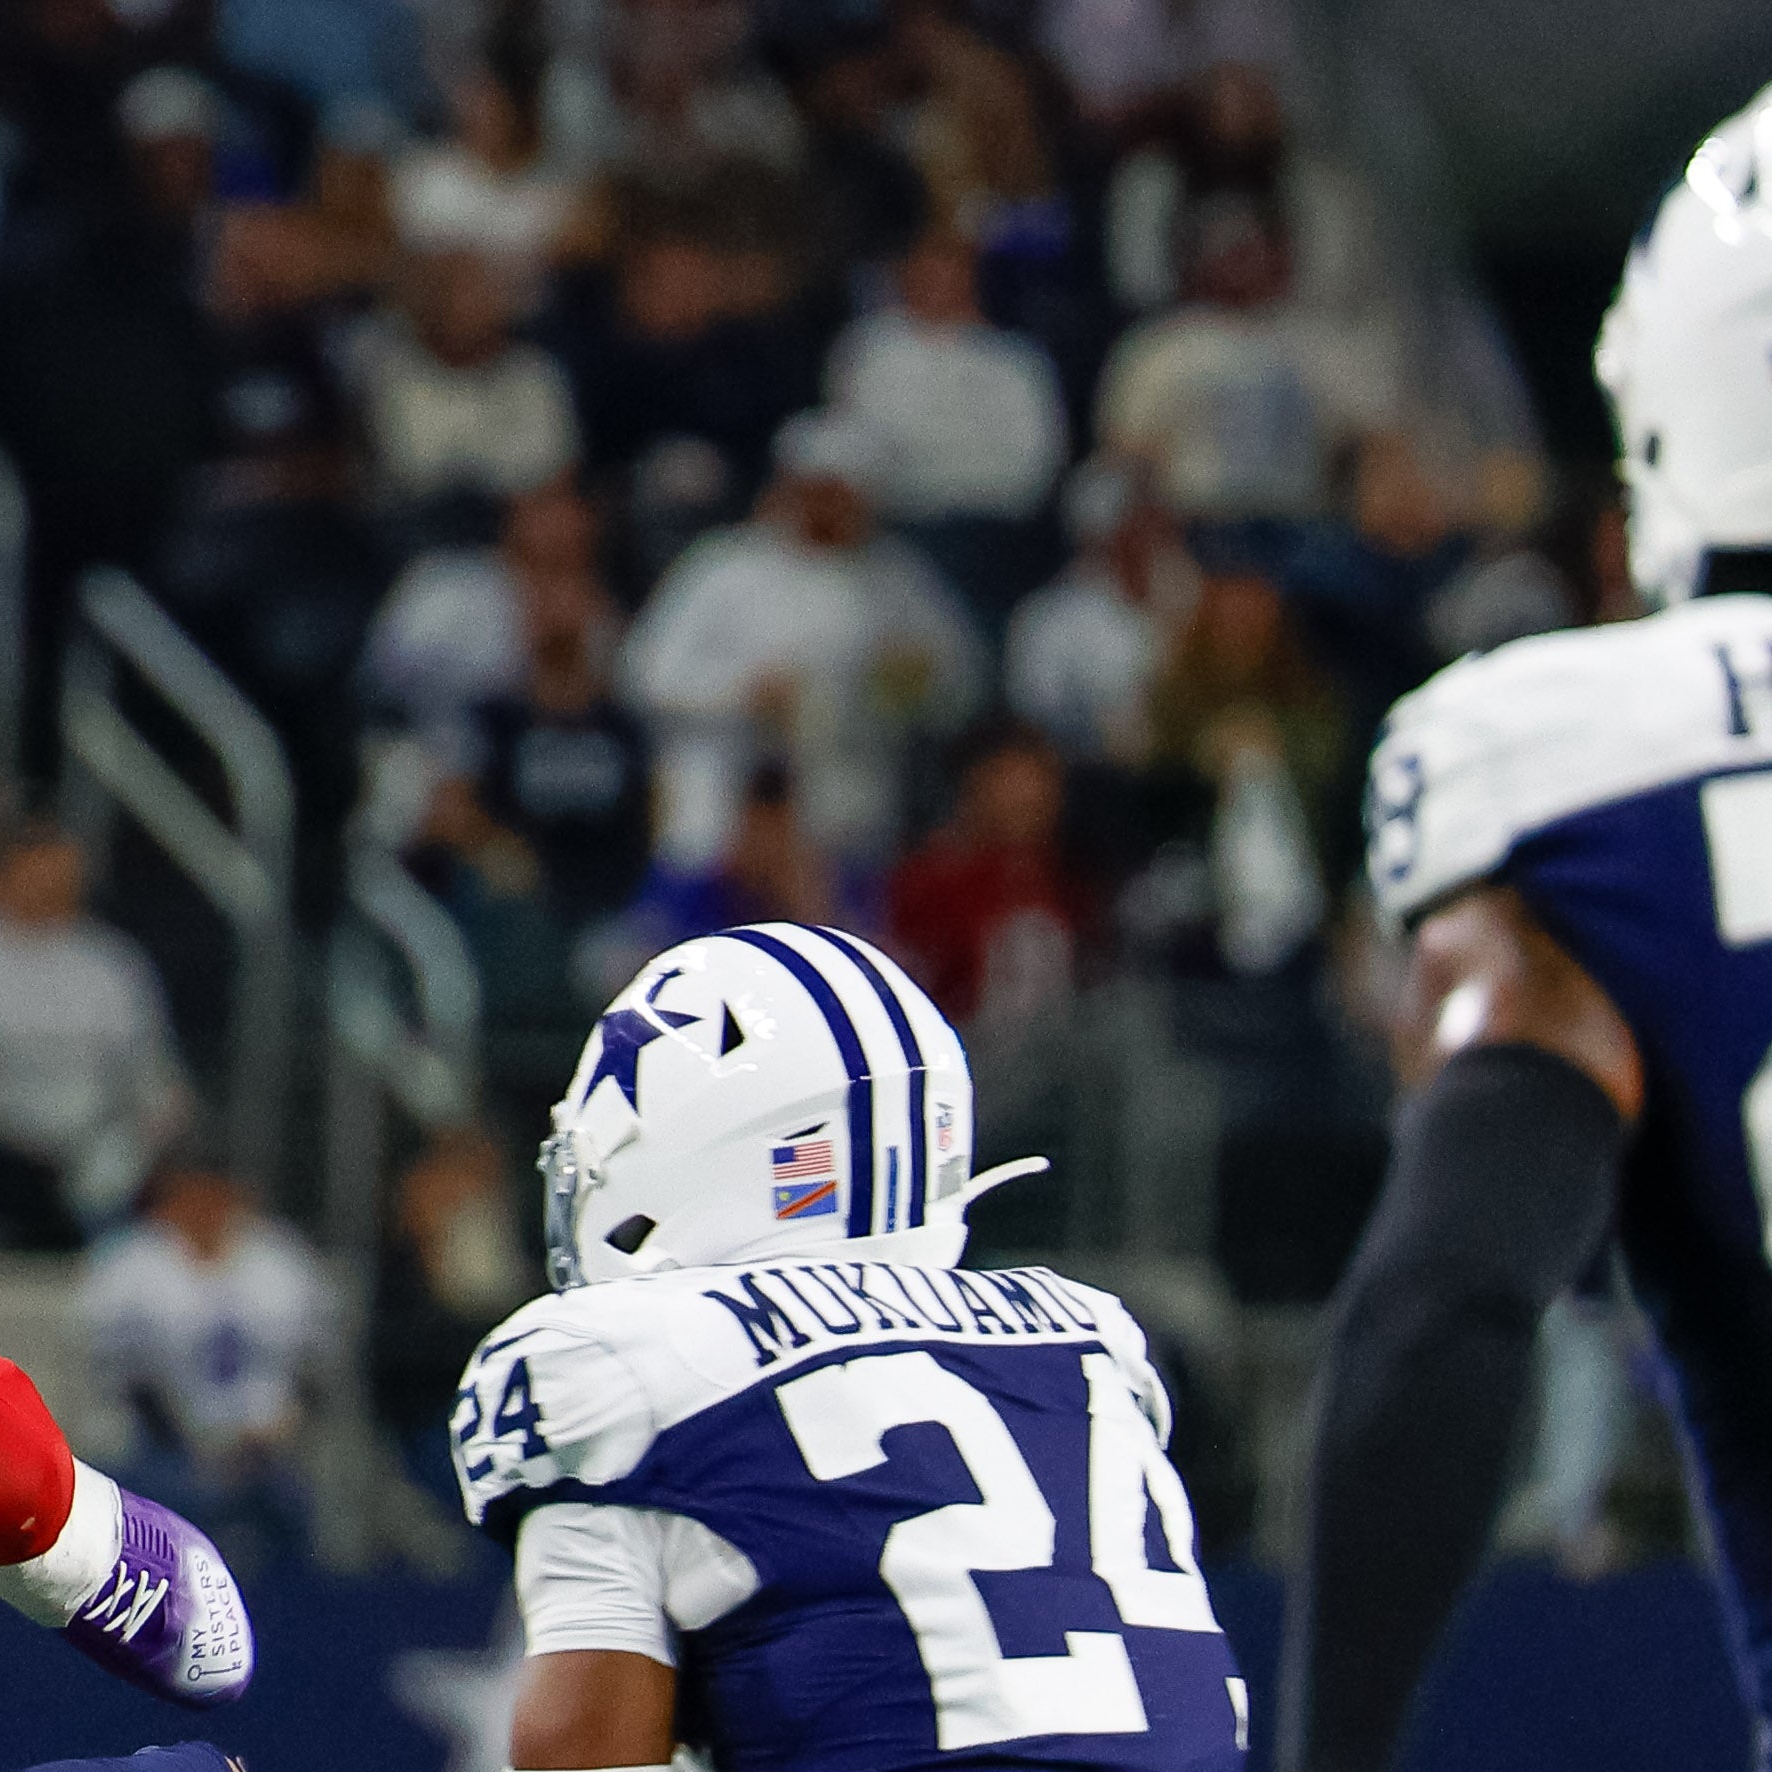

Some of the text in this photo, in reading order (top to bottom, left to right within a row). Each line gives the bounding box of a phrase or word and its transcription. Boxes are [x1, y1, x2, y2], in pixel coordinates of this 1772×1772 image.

[449, 1355, 552, 1482] 24
[775, 1350, 1249, 1752] 24
[190, 1627, 207, 1659] MY
[216, 1575, 242, 1655] PLACE
